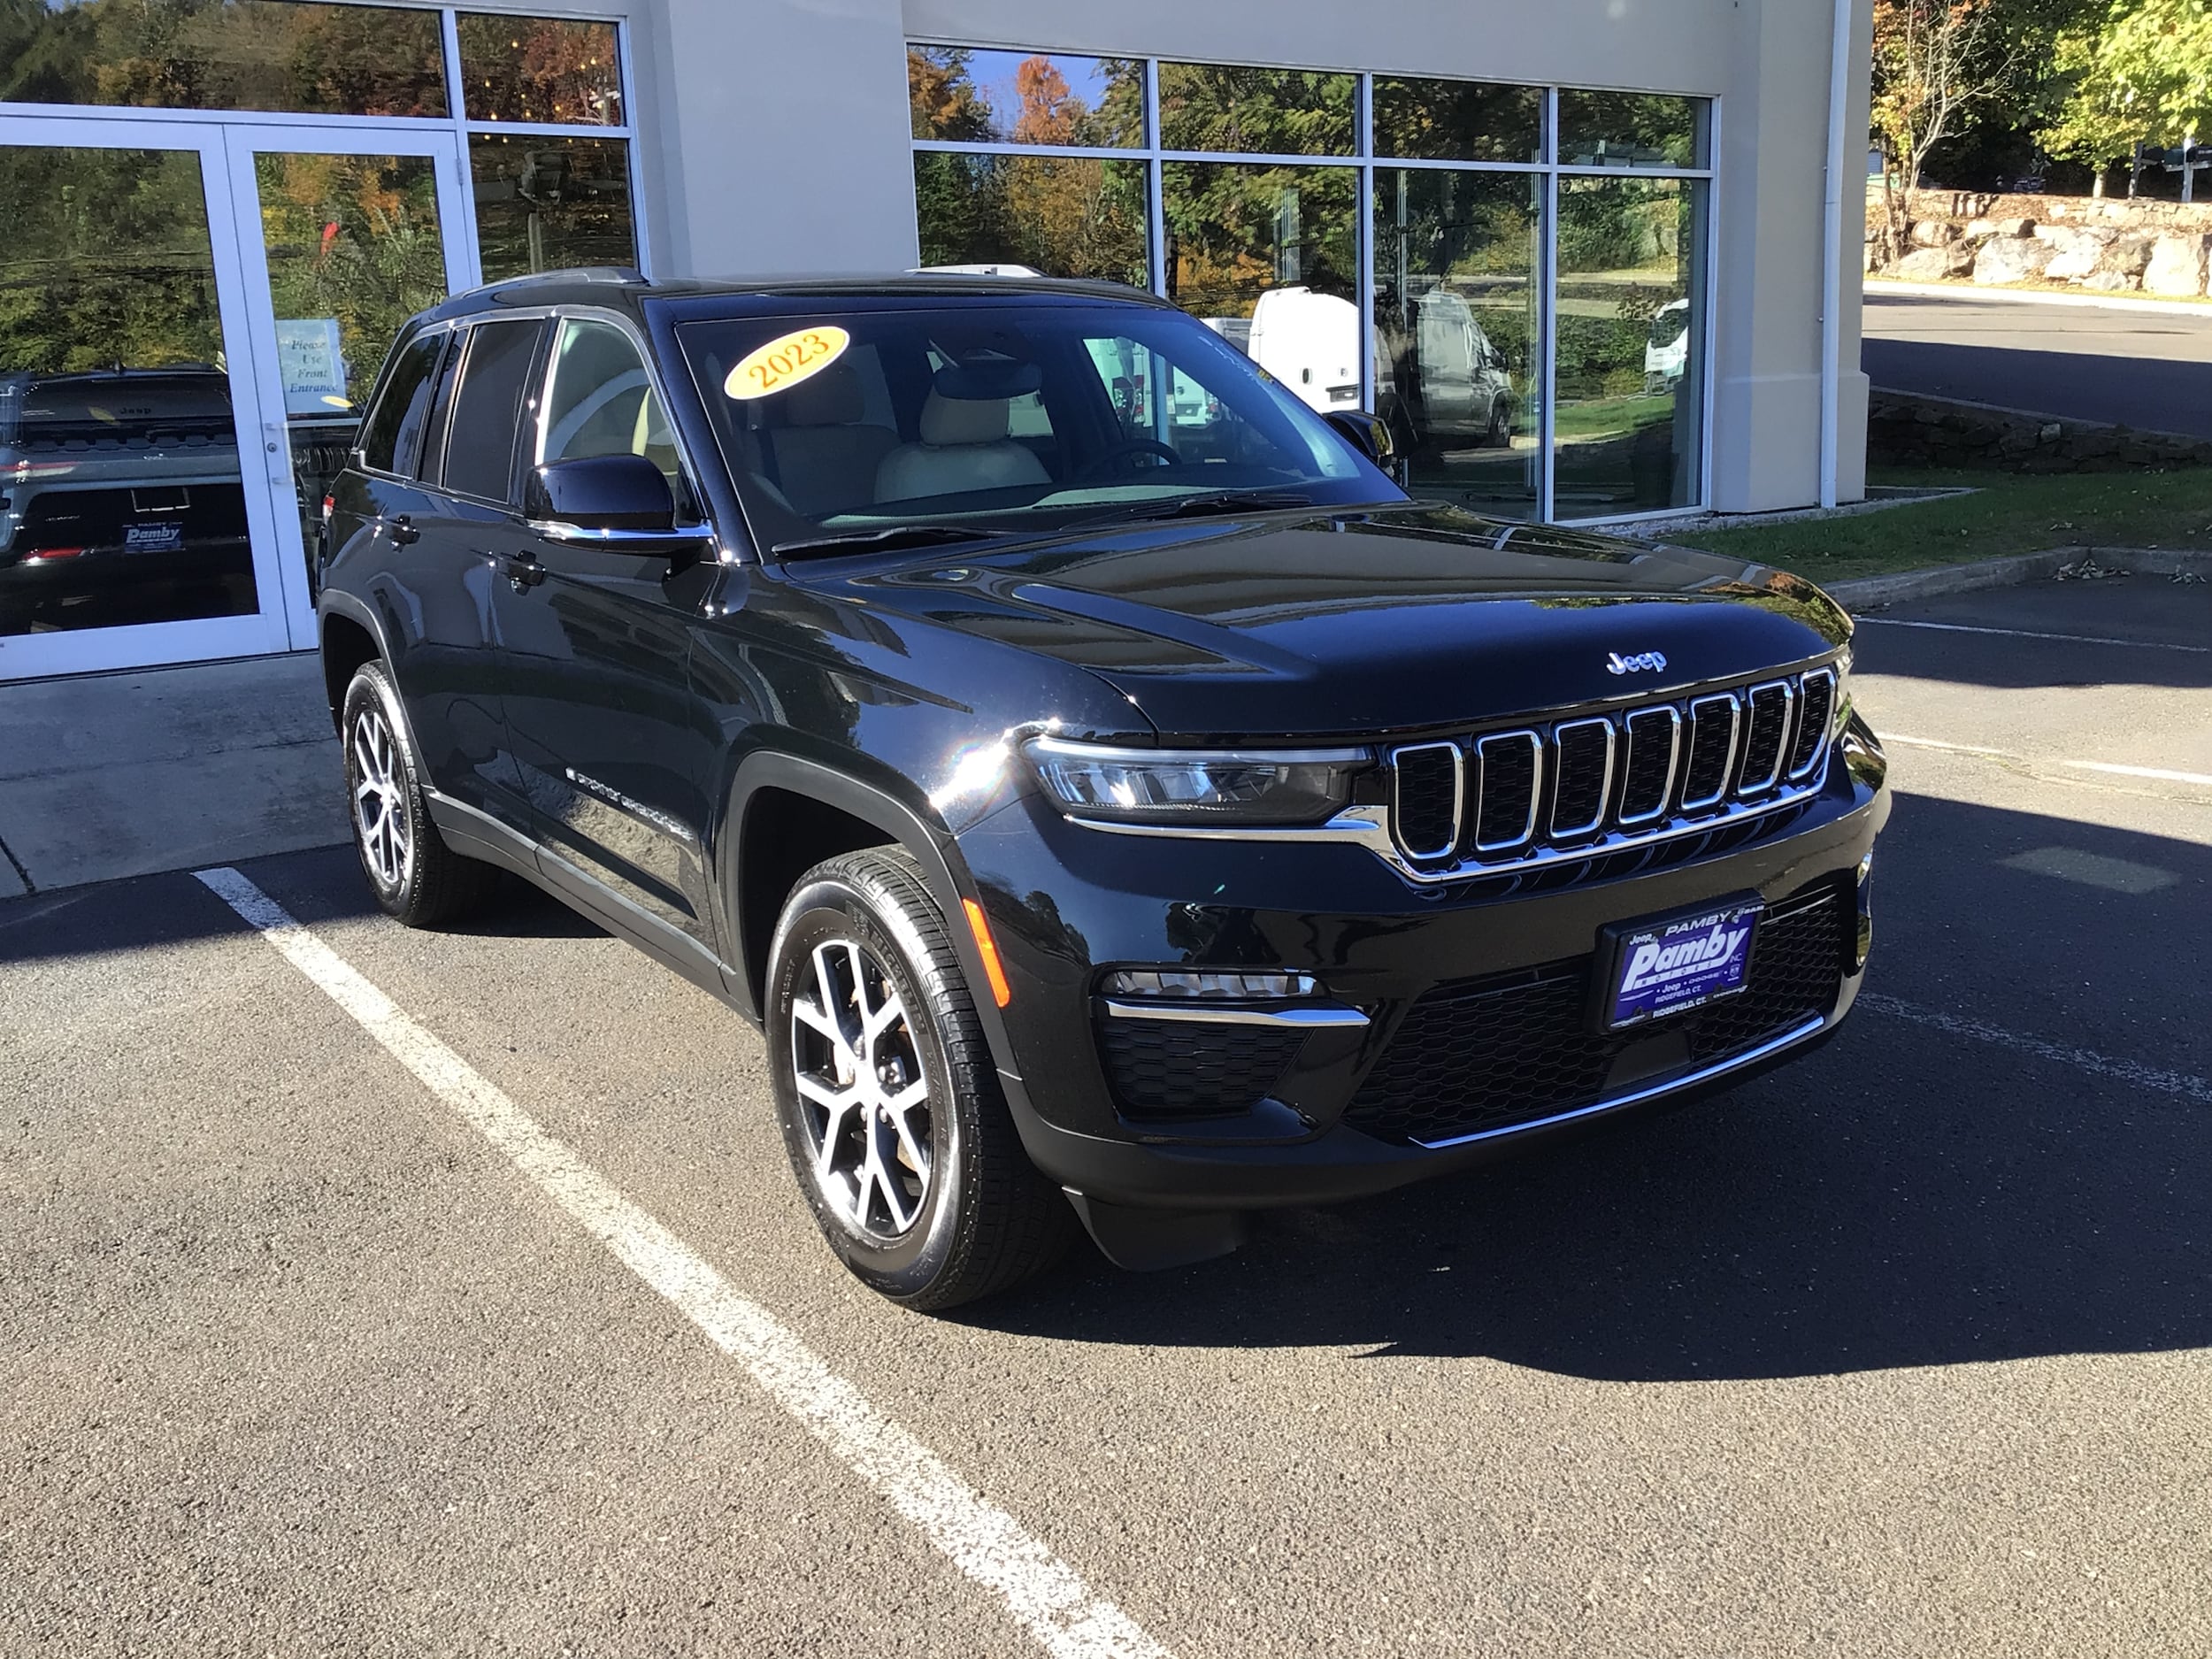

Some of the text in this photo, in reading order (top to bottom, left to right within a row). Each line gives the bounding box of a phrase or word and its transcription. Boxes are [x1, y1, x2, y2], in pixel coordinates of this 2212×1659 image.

[292, 340, 326, 350] Please
[302, 356, 322, 365] Use
[749, 334, 829, 388] 2023
[297, 370, 328, 379] Front
[289, 383, 338, 393] Entrance
[126, 526, 180, 544] Pamby
[1606, 651, 1667, 675] Jeep
[1664, 910, 1732, 936] PAMBY
[1629, 933, 1653, 945] Jeep
[1620, 925, 1749, 993] Pamby
[869, 929, 926, 1035] MICHELIN
[1663, 982, 1682, 994] Jeep
